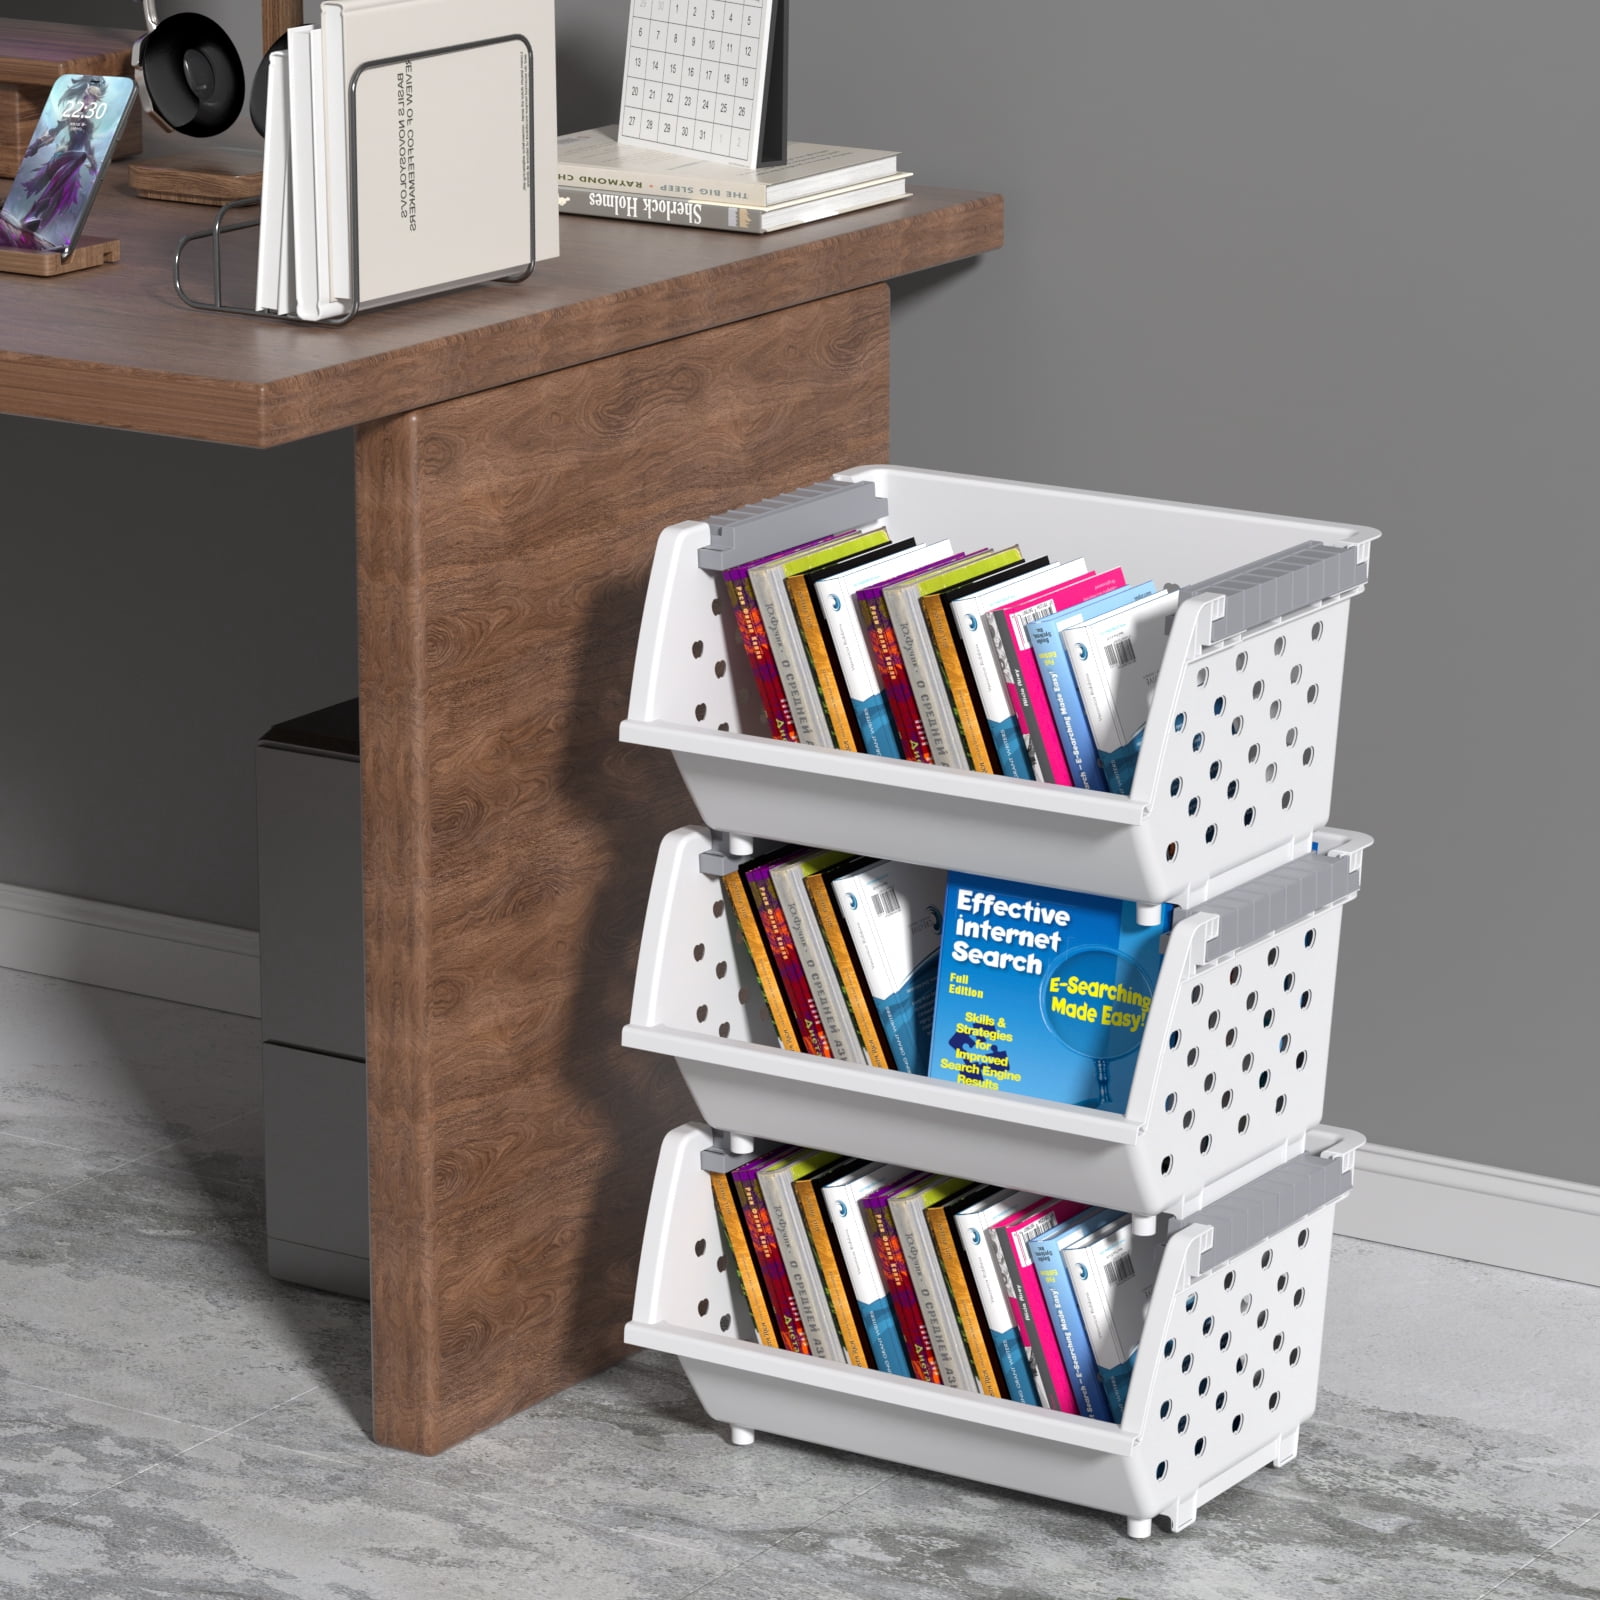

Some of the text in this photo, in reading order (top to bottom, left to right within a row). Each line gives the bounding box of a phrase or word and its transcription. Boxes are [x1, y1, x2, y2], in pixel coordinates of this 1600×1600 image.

[709, 40, 715, 50] 10
[727, 43, 733, 52] 11
[745, 46, 752, 57] 12
[635, 57, 749, 87] 13 14 15 16 17 18 19
[62, 101, 107, 119] 22:30
[631, 86, 746, 117] 20 21 22 23 24 25 26
[628, 116, 636, 126] 27
[646, 119, 653, 130] 28
[663, 122, 671, 133] 29
[681, 126, 689, 137] 30
[699, 129, 706, 140] 31
[579, 175, 642, 188] RAYMOND
[660, 184, 694, 194] SLEEP
[699, 188, 720, 196] BIG
[726, 190, 748, 199] THE
[588, 192, 702, 224] Sherlock Holmes
[1048, 670, 1061, 692] Easy!
[781, 659, 790, 668] О
[786, 672, 810, 734] СРЕДНЕЙ
[1055, 693, 1067, 715] Made
[915, 679, 925, 689] О
[921, 693, 946, 756] СРЕДНЕЙ
[1062, 715, 1082, 764] E-Searching
[957, 888, 1071, 927] Effective
[951, 940, 1043, 975] Search
[949, 972, 969, 984] Full
[806, 958, 815, 968] О
[812, 972, 838, 1033] СРЕДНЕЙ
[948, 984, 984, 999] Edition
[1049, 976, 1152, 1013] E-Searching
[965, 1012, 1006, 1028] Skills &
[1051, 996, 1147, 1032] Made Easy!
[955, 1024, 1013, 1042] Strategies
[975, 1040, 992, 1051] for
[955, 1048, 1009, 1068] Improved
[940, 1059, 1022, 1082] Search Engine
[957, 1075, 999, 1091] Results
[789, 1259, 798, 1269] О
[794, 1272, 819, 1333] СРЕДНЕЙ
[1049, 1287, 1062, 1308] Easy!
[920, 1287, 930, 1297] О
[926, 1301, 951, 1362] СРЕДНЕЙ
[1056, 1309, 1068, 1330] Made
[1064, 1331, 1083, 1378] E-Searching
